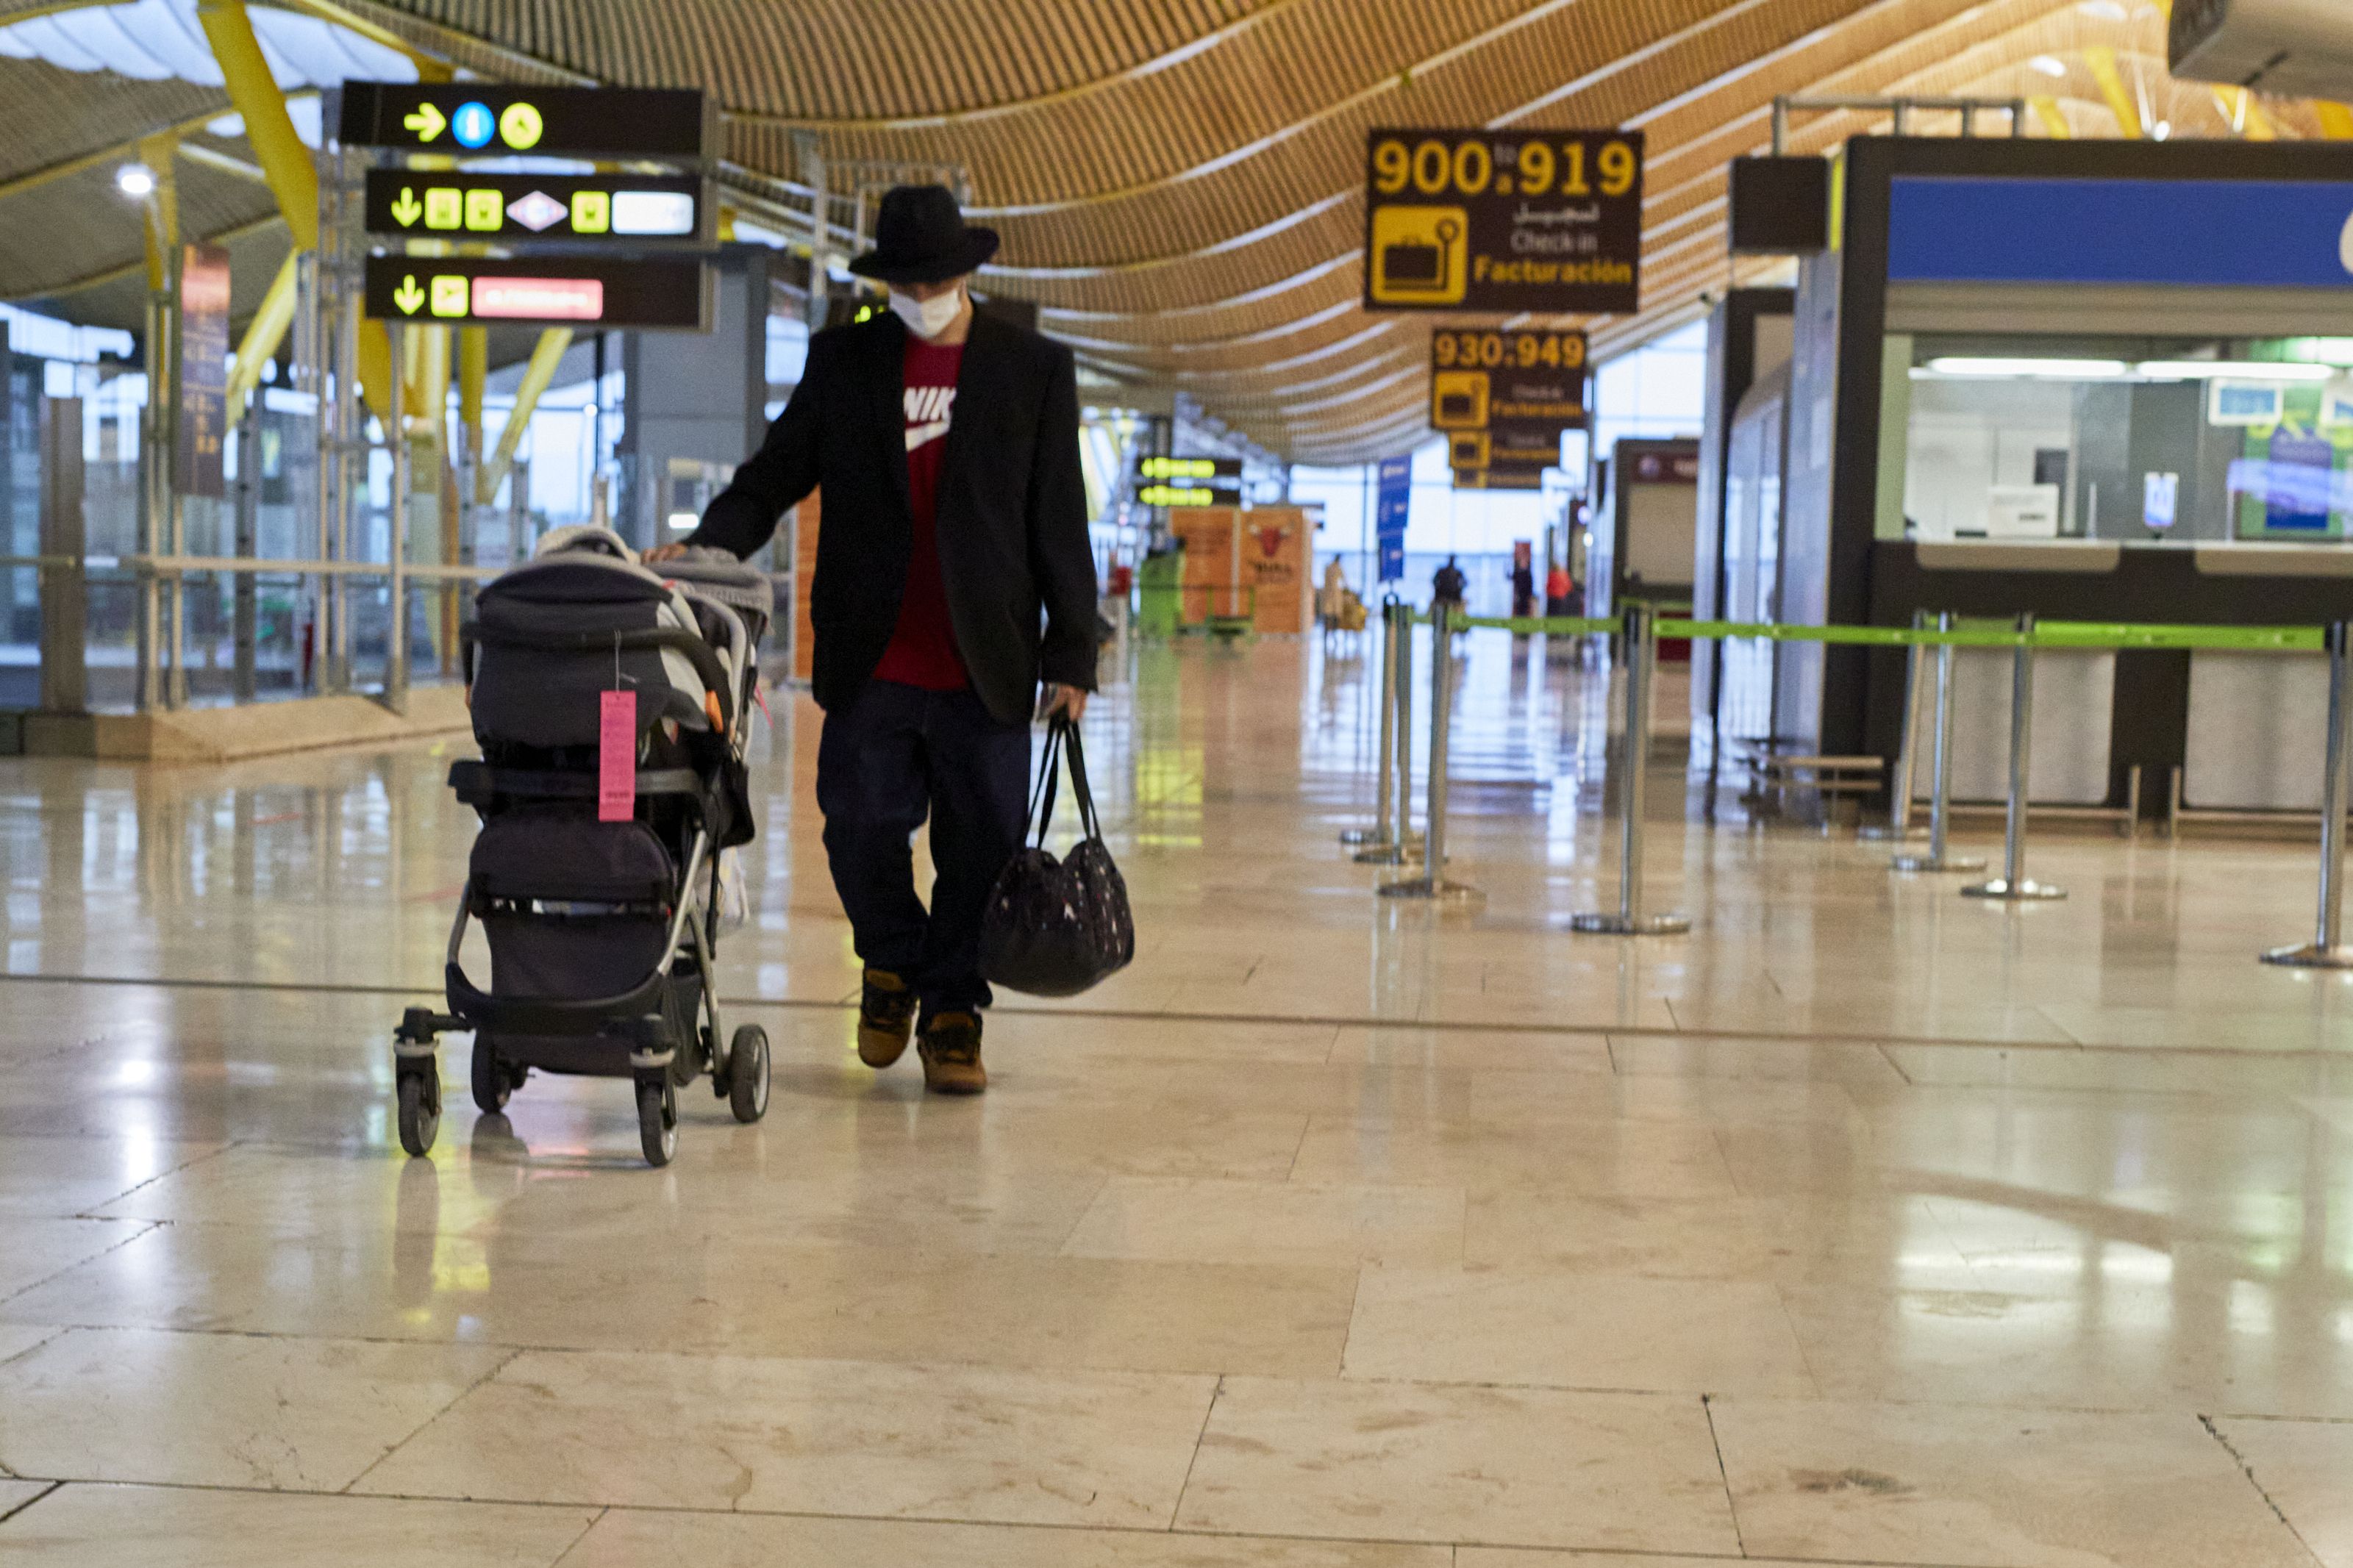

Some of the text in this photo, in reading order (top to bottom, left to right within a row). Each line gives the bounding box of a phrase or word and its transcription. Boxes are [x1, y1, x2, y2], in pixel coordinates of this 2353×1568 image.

[1373, 139, 1493, 195] 900
[1518, 140, 1636, 196] 919
[1474, 254, 1632, 284] Facturación
[1435, 333, 1503, 367] 930
[1516, 334, 1585, 368] 949
[903, 386, 957, 422] NIK
